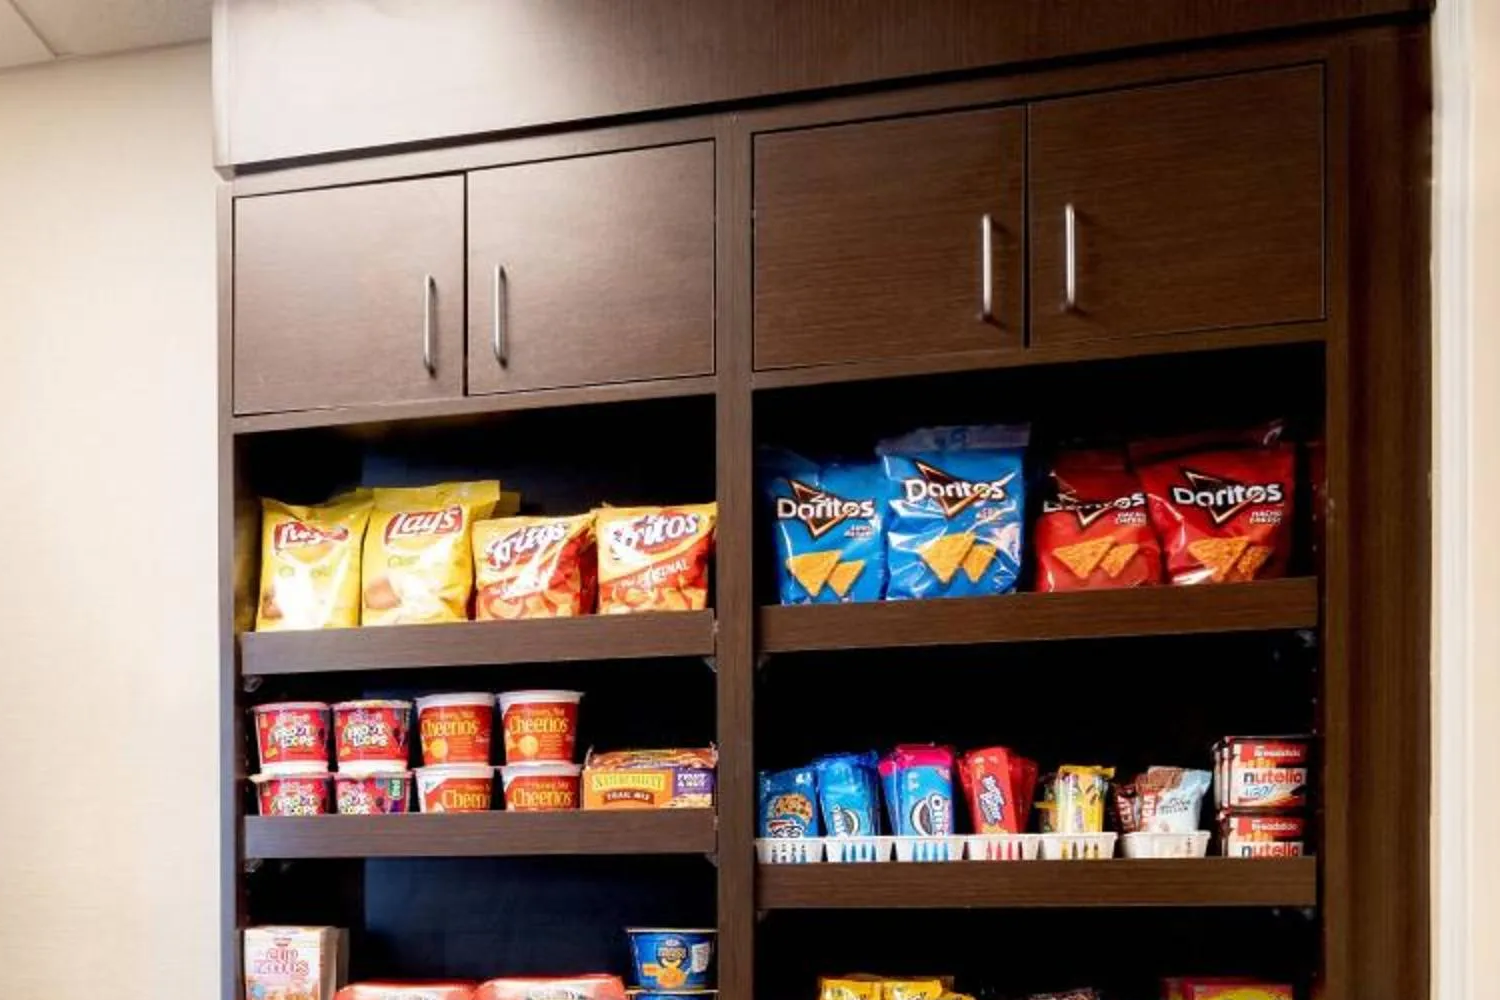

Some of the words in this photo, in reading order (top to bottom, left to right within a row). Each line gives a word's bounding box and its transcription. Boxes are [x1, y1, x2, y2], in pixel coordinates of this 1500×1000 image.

[904, 478, 1005, 501] Doritos
[1173, 483, 1283, 505] Doritos
[777, 498, 875, 520] Doritos
[421, 719, 479, 737] Cheerios
[509, 715, 569, 734] Cheerios
[1244, 769, 1303, 785] nutella
[512, 787, 573, 808] Cheerios
[1241, 844, 1299, 858] nutella
